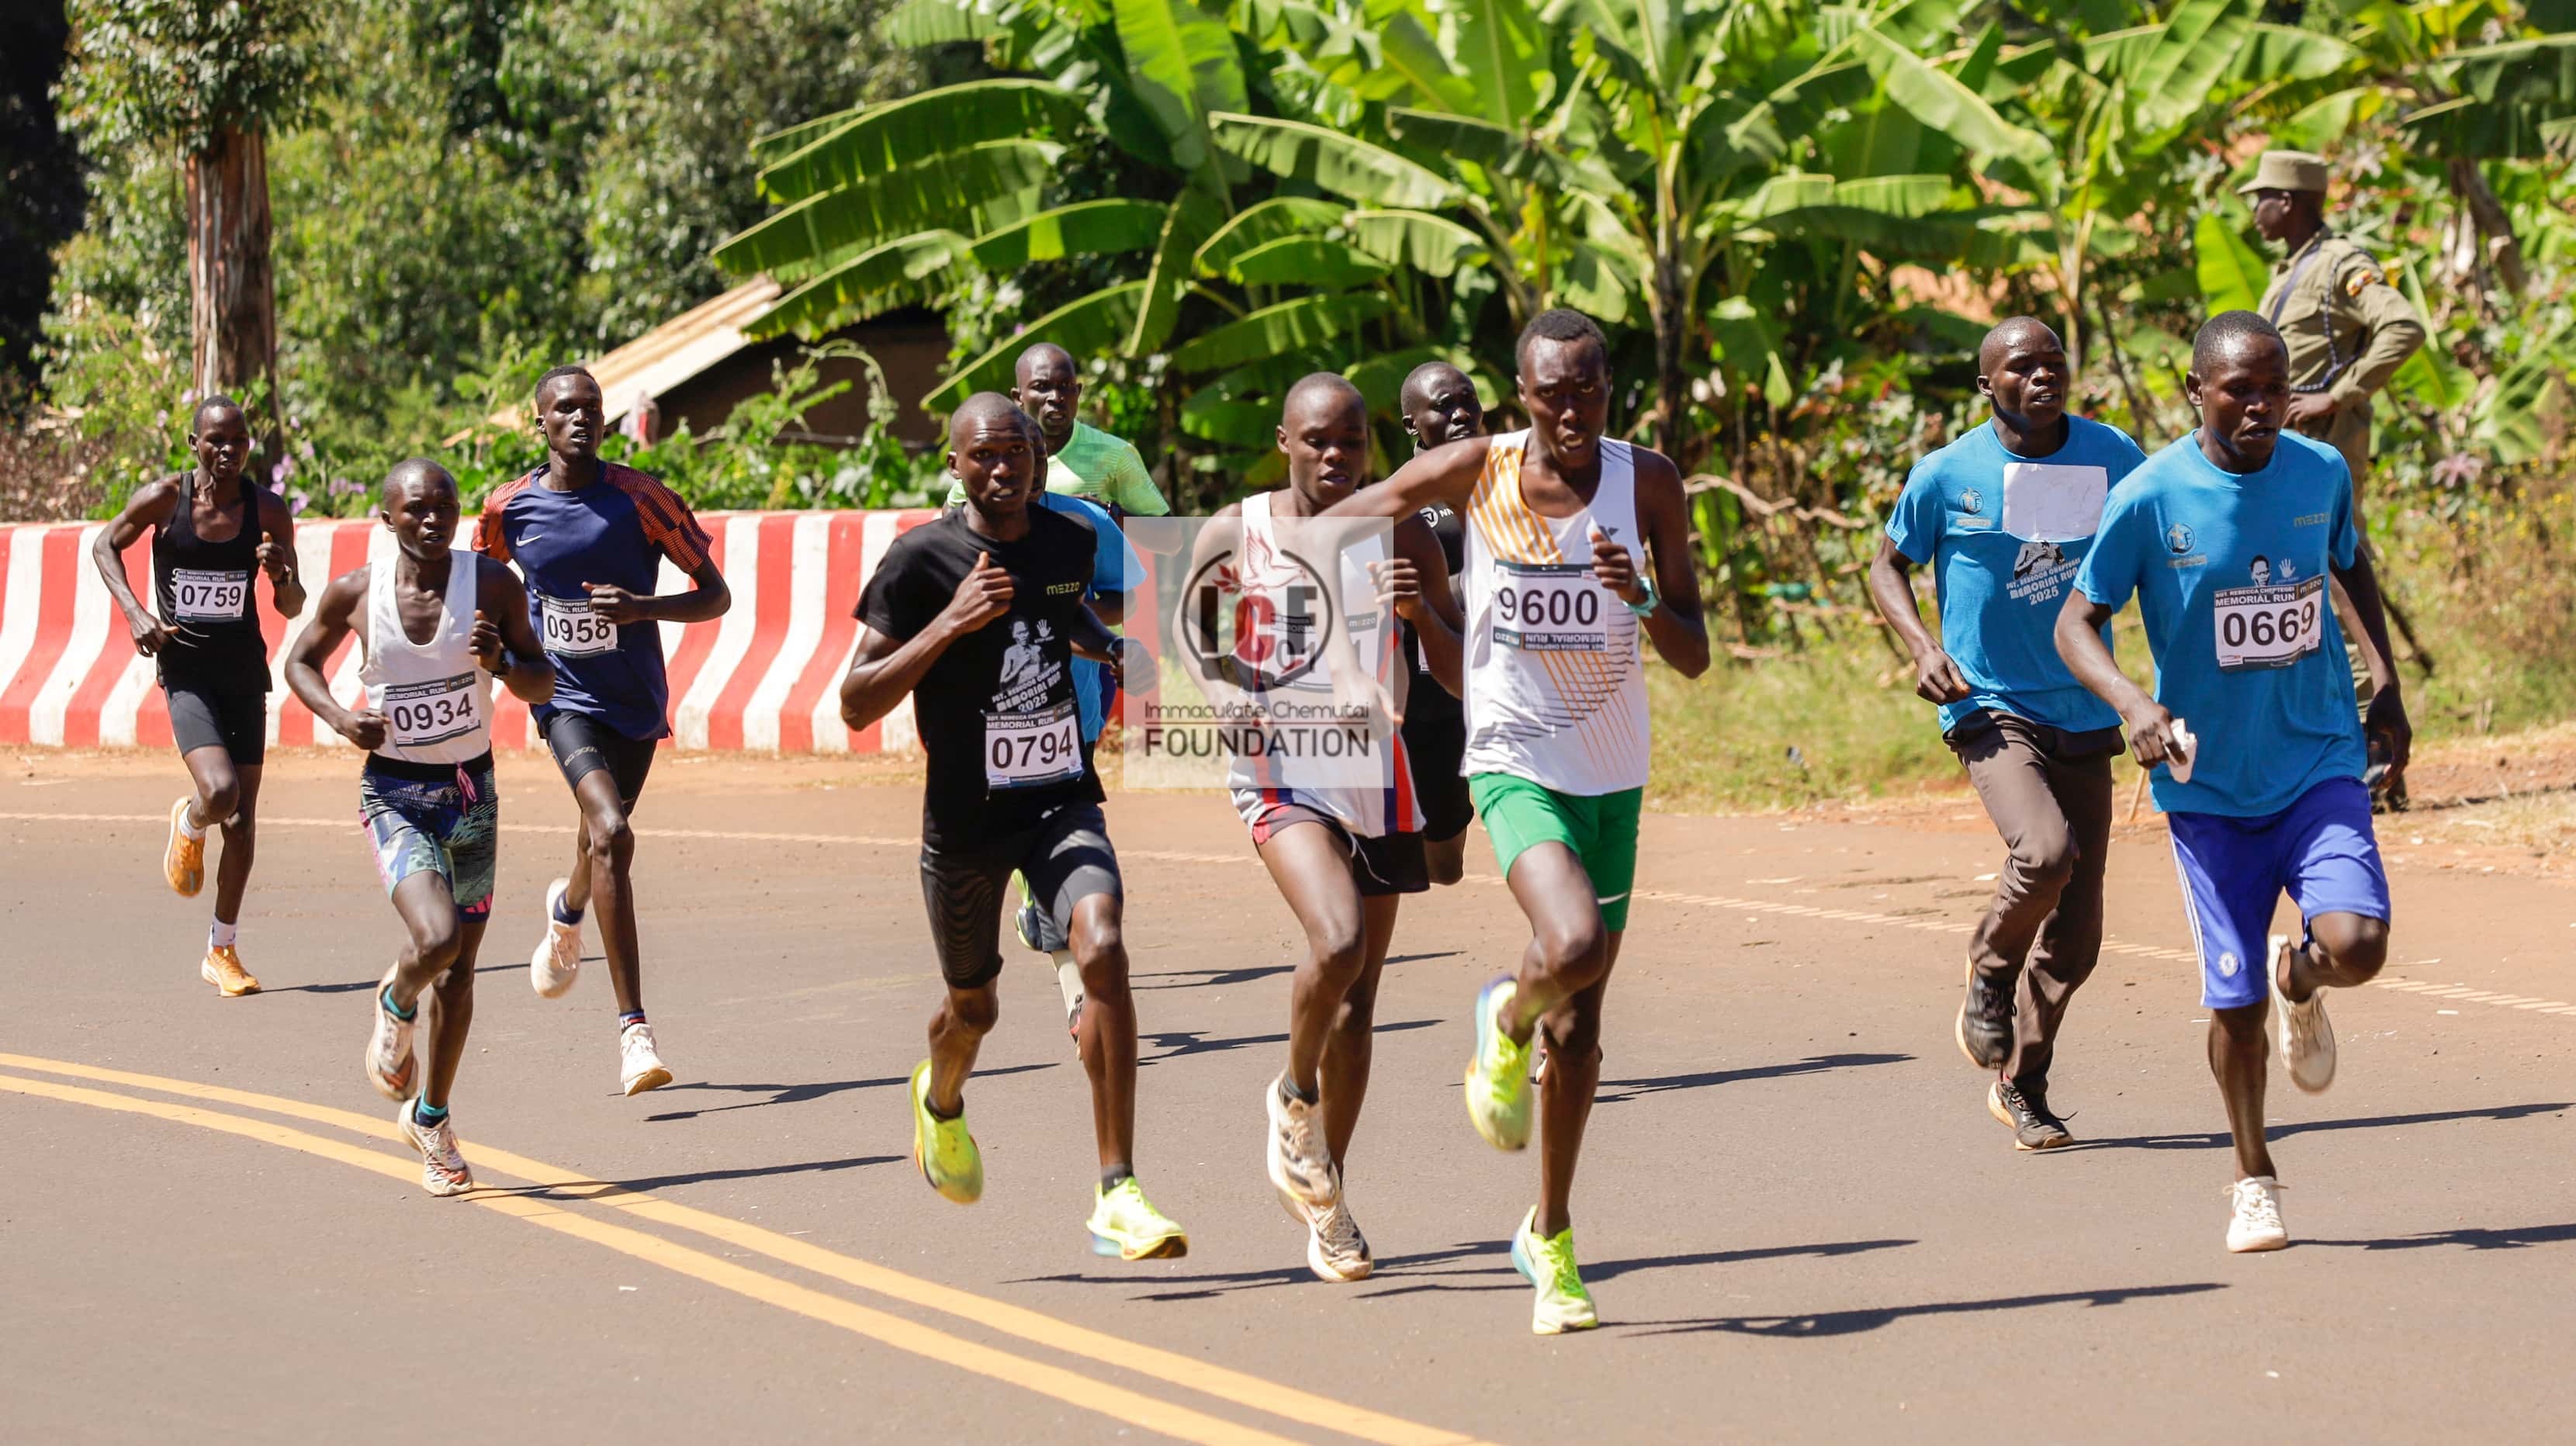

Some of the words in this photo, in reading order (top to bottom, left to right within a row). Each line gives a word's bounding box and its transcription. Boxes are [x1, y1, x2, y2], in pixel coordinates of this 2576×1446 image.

[181, 585, 241, 607] 0759
[2029, 585, 2059, 606] 2025
[2215, 595, 2270, 607] MEMORIAL
[2273, 593, 2295, 603] RUN
[547, 614, 611, 643] 0958
[2223, 601, 2315, 647] 0669
[1525, 634, 1548, 642] RUN
[1550, 634, 1605, 642] MEMORIAL
[429, 687, 448, 695] RUN
[393, 693, 473, 732] 0934
[1018, 693, 1048, 712] 2025
[986, 720, 1037, 729] MEMORIAL
[1037, 717, 1054, 726] RUN
[992, 725, 1073, 769] 0794
